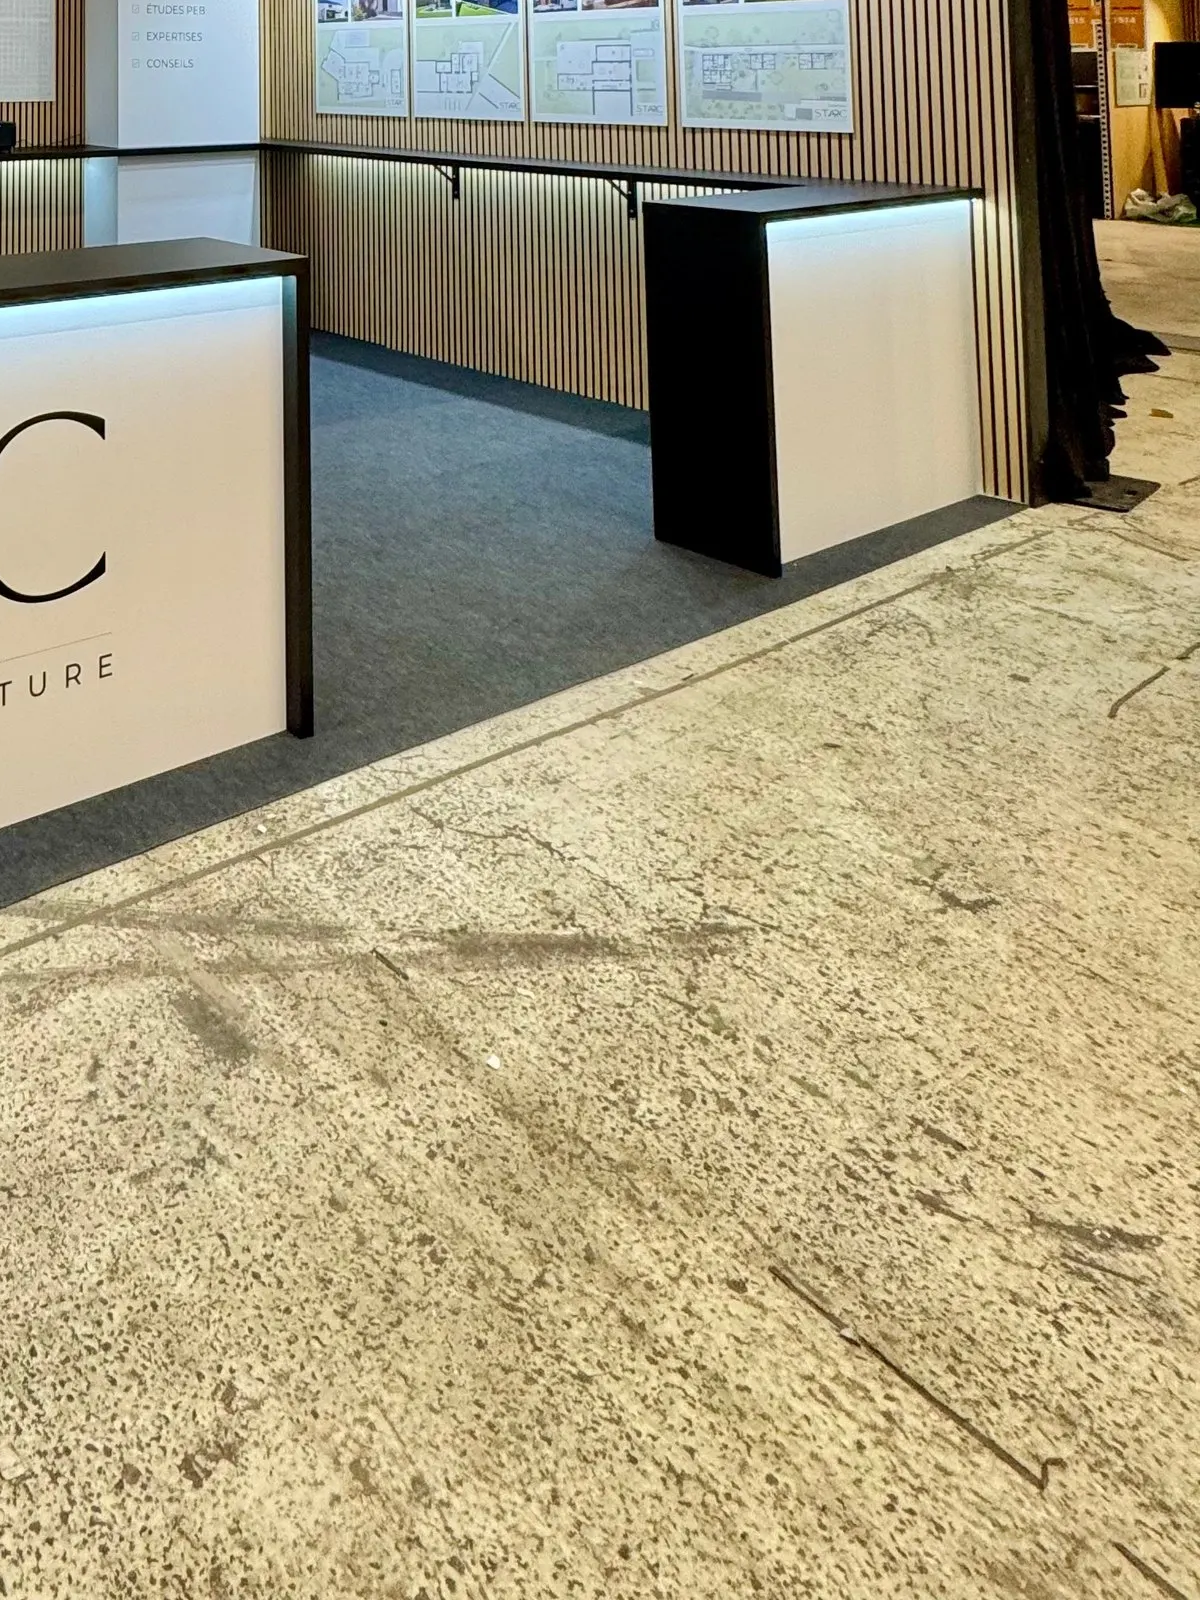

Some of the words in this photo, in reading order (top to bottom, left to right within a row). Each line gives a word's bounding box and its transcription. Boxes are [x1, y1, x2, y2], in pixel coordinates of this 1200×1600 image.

[146, 2, 184, 14] ÉTUDES
[186, 6, 206, 15] PEB
[146, 32, 203, 41] EXPERTISES
[146, 59, 194, 68] CONSEILS
[814, 109, 847, 118] STARC
